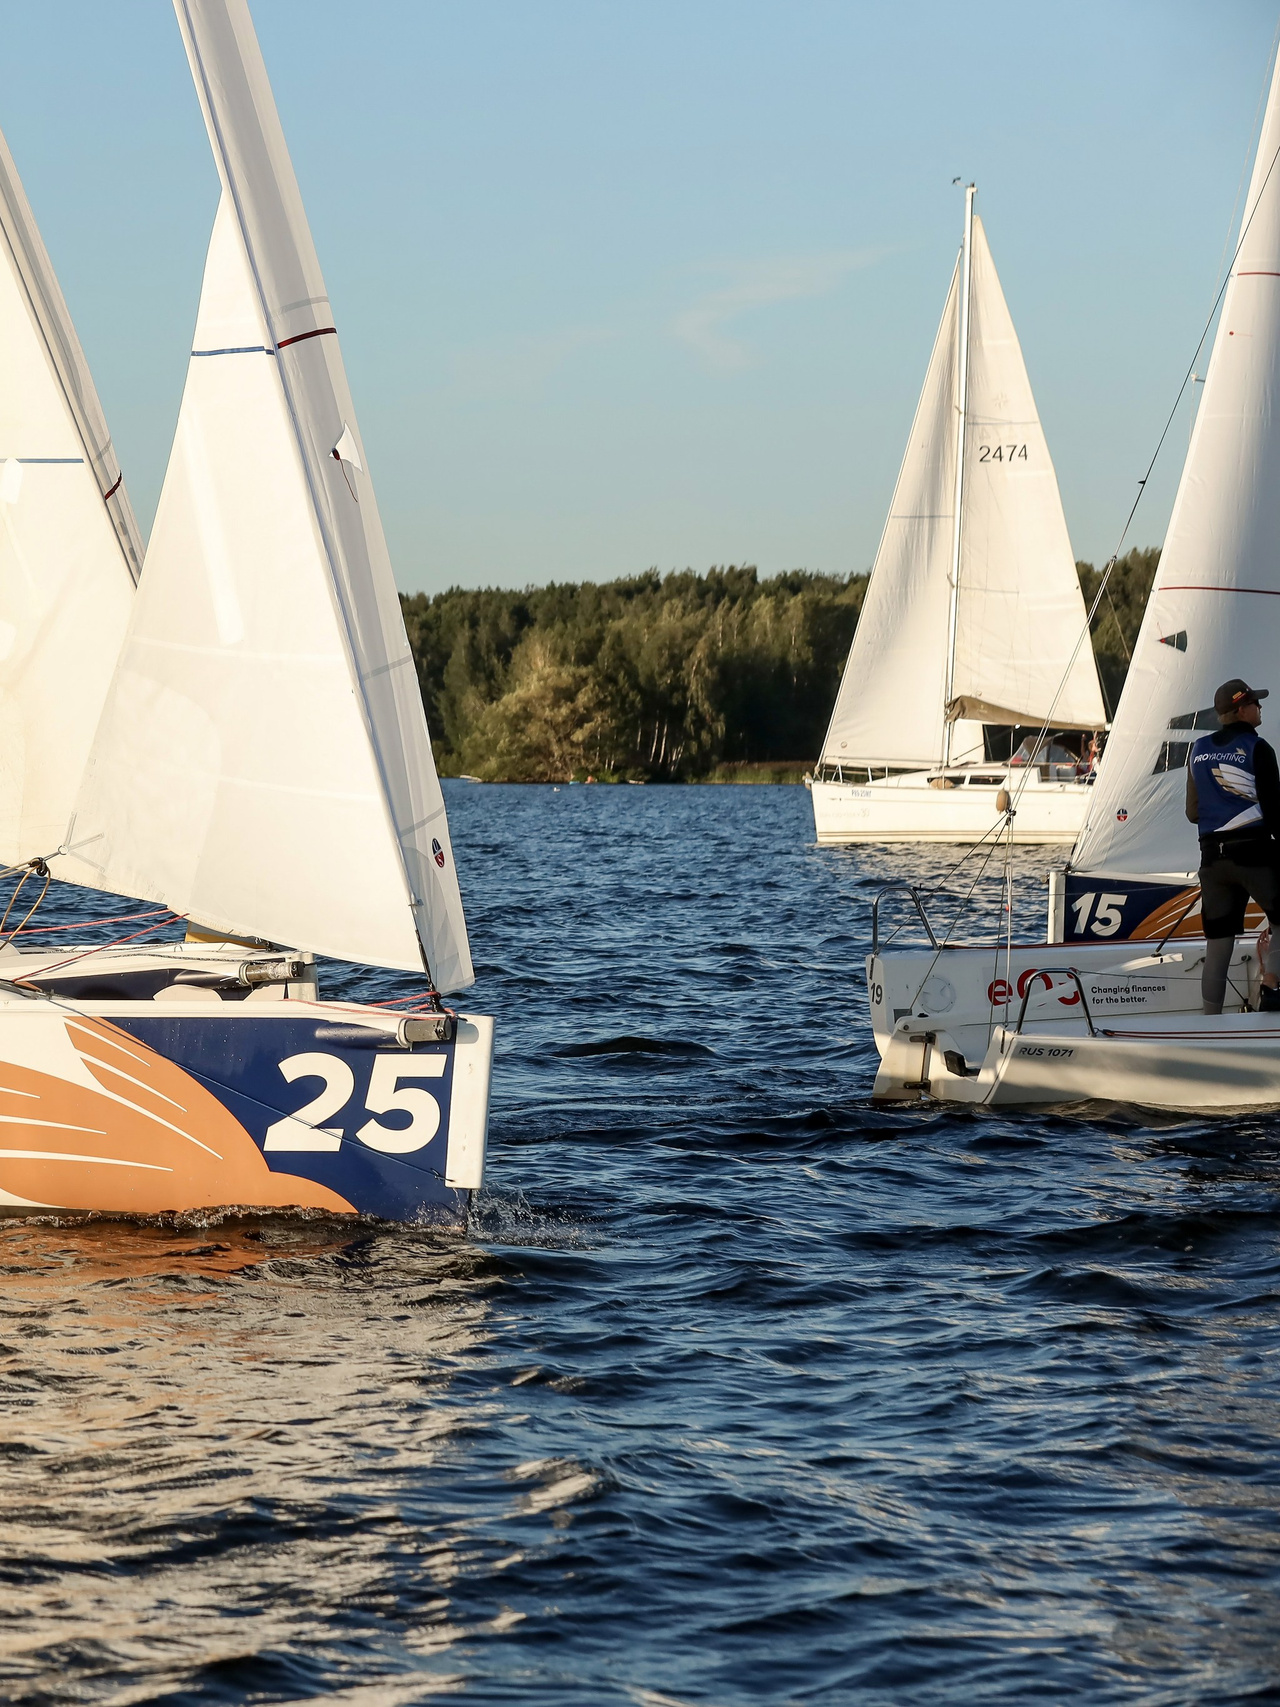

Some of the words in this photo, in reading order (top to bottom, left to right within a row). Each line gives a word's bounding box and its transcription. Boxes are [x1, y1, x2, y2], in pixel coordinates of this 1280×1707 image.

[978, 444, 1028, 462] 2474
[1193, 752, 1247, 764] PROYACHTING
[1071, 892, 1128, 937] 15
[870, 982, 883, 1005] 19
[1091, 986, 1130, 994] Changing
[1106, 996, 1119, 1004] the
[1019, 1047, 1045, 1056] RUS
[1048, 1048, 1074, 1058] 1071
[263, 1052, 448, 1154] 25
